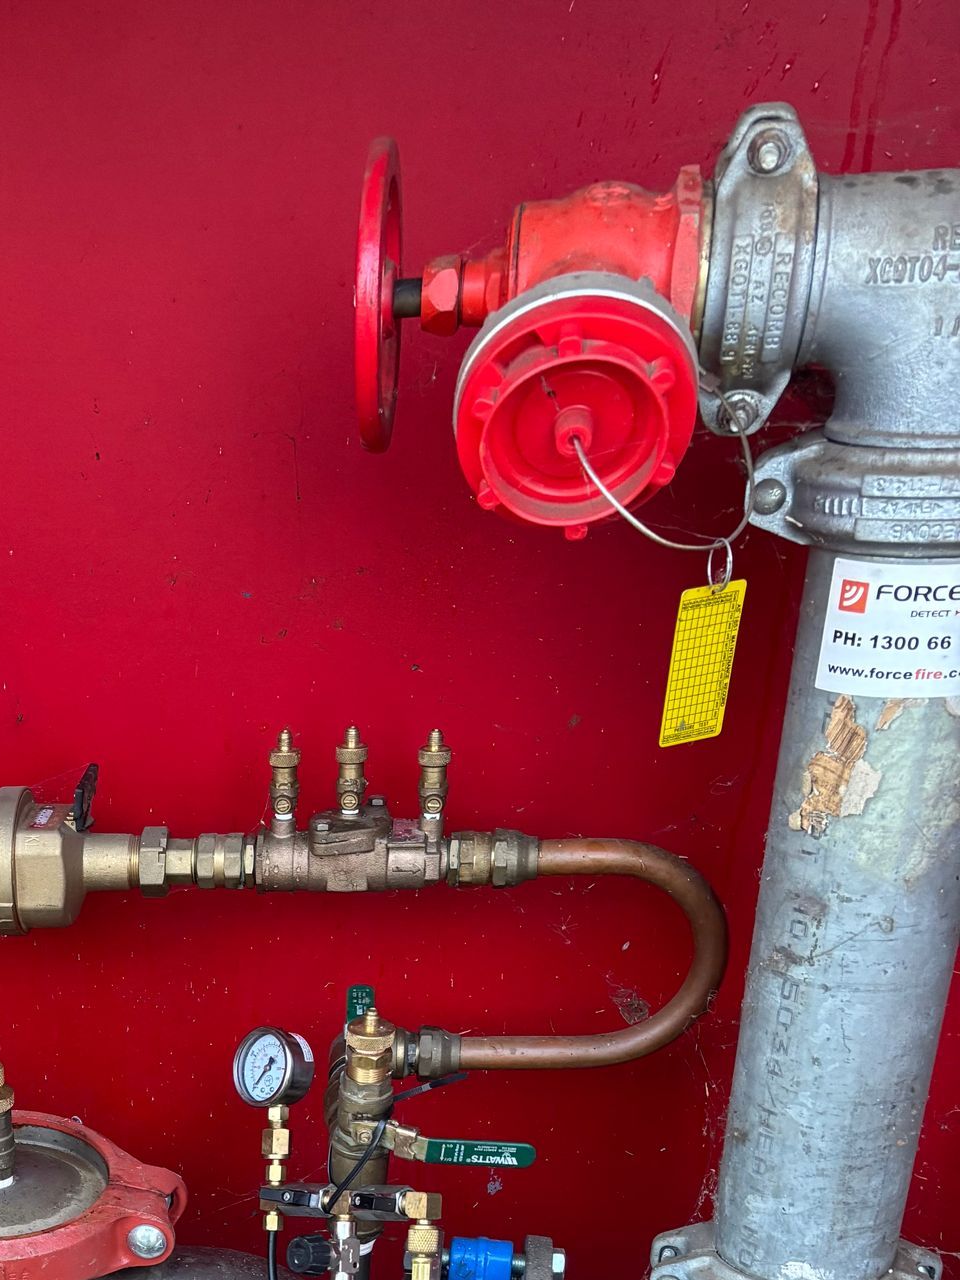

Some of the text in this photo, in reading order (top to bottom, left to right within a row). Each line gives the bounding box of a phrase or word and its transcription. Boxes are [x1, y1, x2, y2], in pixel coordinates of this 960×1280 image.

[764, 252, 792, 350] RECOMB
[889, 524, 960, 541] ECOMB
[910, 610, 951, 618] DETECT
[833, 629, 951, 650] PH: 1300 66
